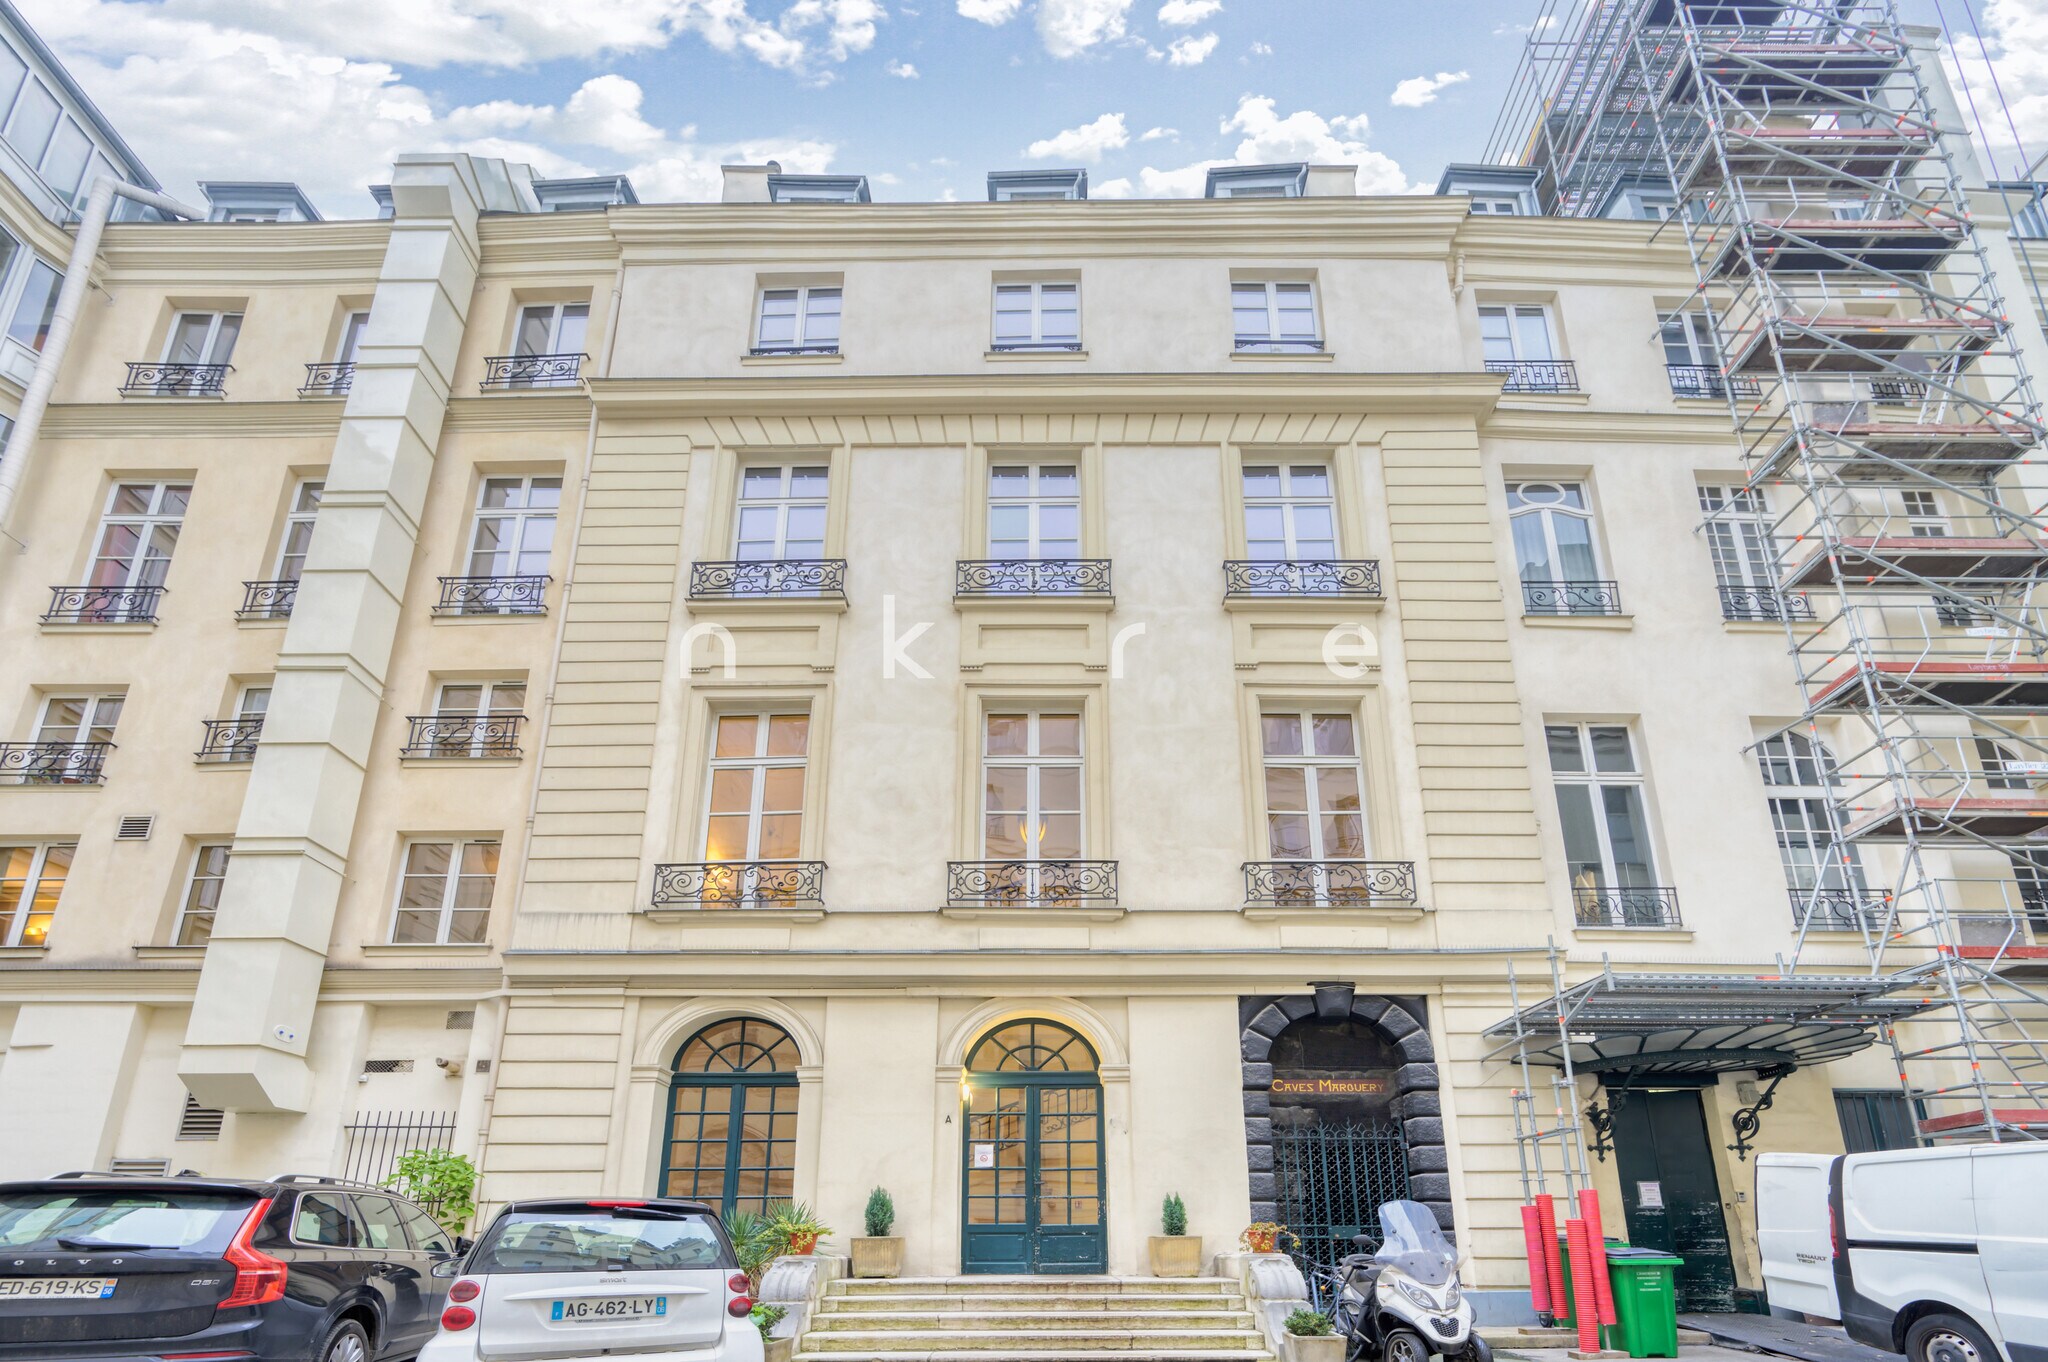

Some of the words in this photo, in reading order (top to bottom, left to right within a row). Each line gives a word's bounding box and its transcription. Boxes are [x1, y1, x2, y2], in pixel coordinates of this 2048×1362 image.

[1271, 1079, 1314, 1092] CAVES
[945, 1114, 952, 1124] A
[565, 1299, 654, 1318] AG-462-LY
